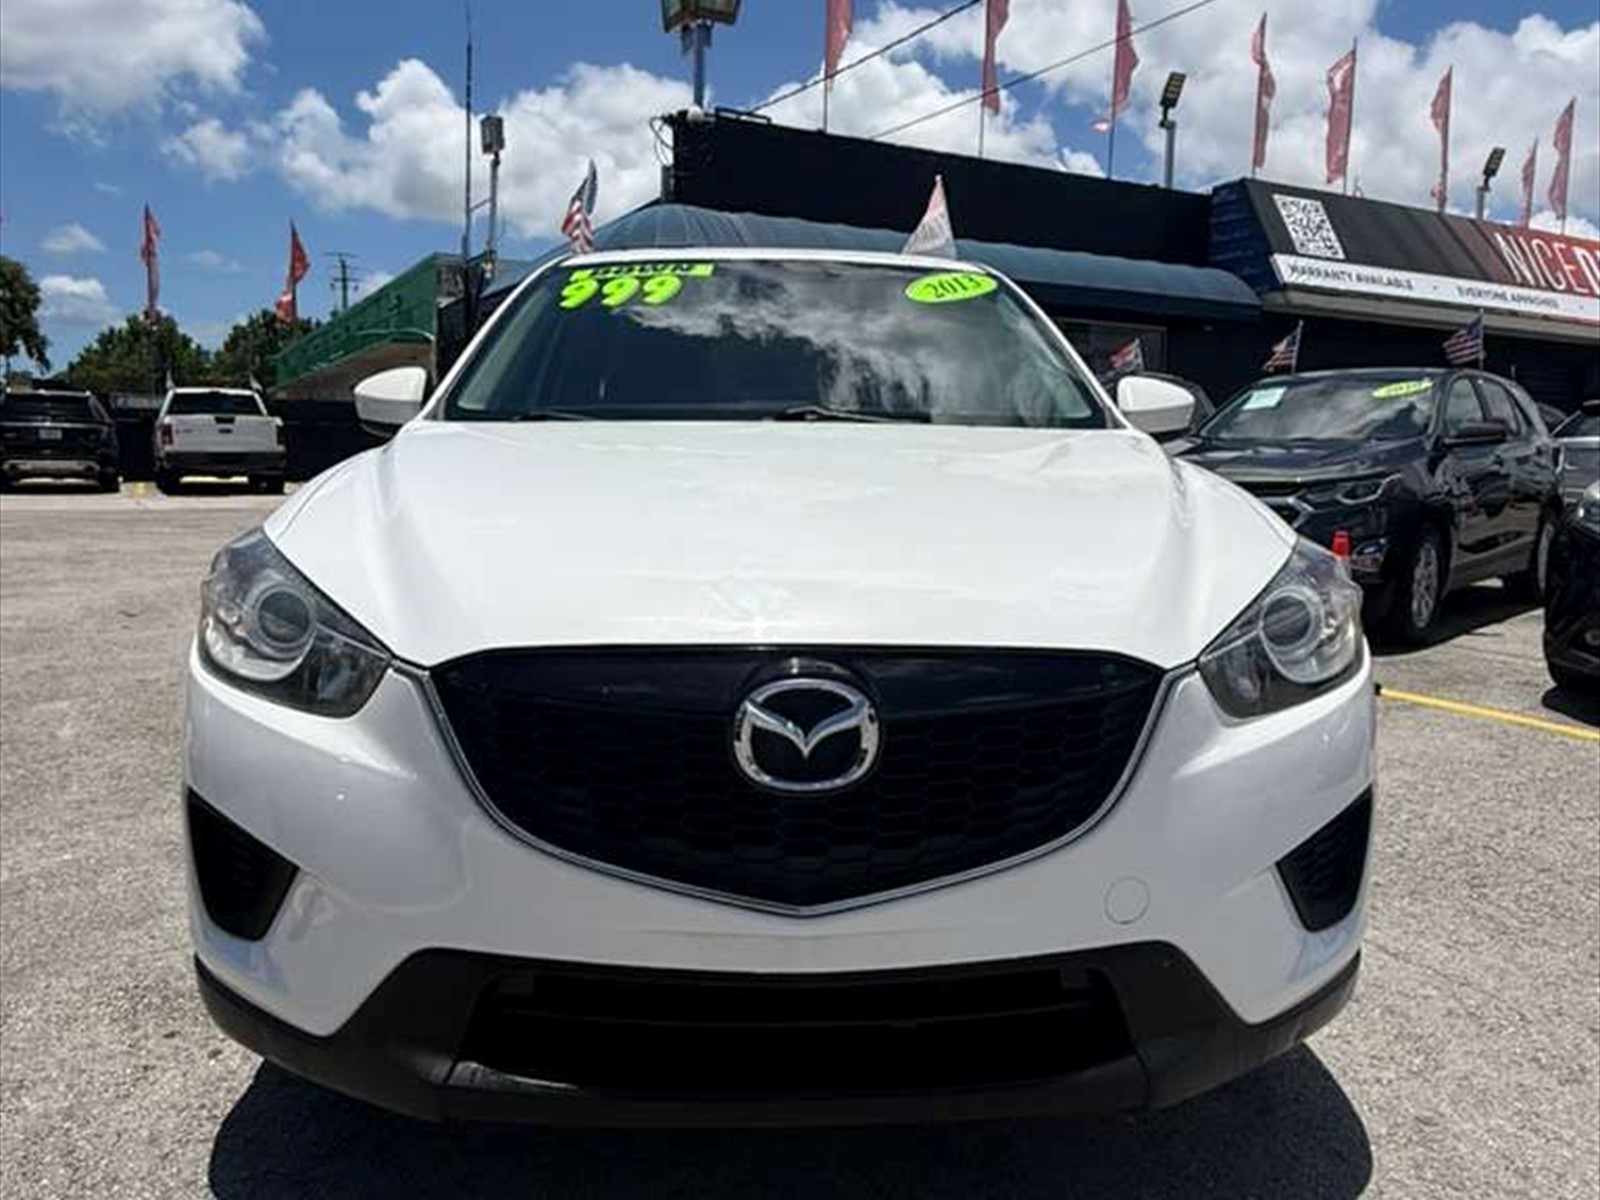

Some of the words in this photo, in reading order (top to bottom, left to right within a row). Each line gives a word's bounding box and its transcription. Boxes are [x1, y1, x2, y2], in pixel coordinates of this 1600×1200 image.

[1287, 263, 1352, 283] WARRANTY
[1355, 272, 1414, 291] AVAILABLE
[1494, 231, 1600, 296] NICED
[559, 275, 682, 309] 999
